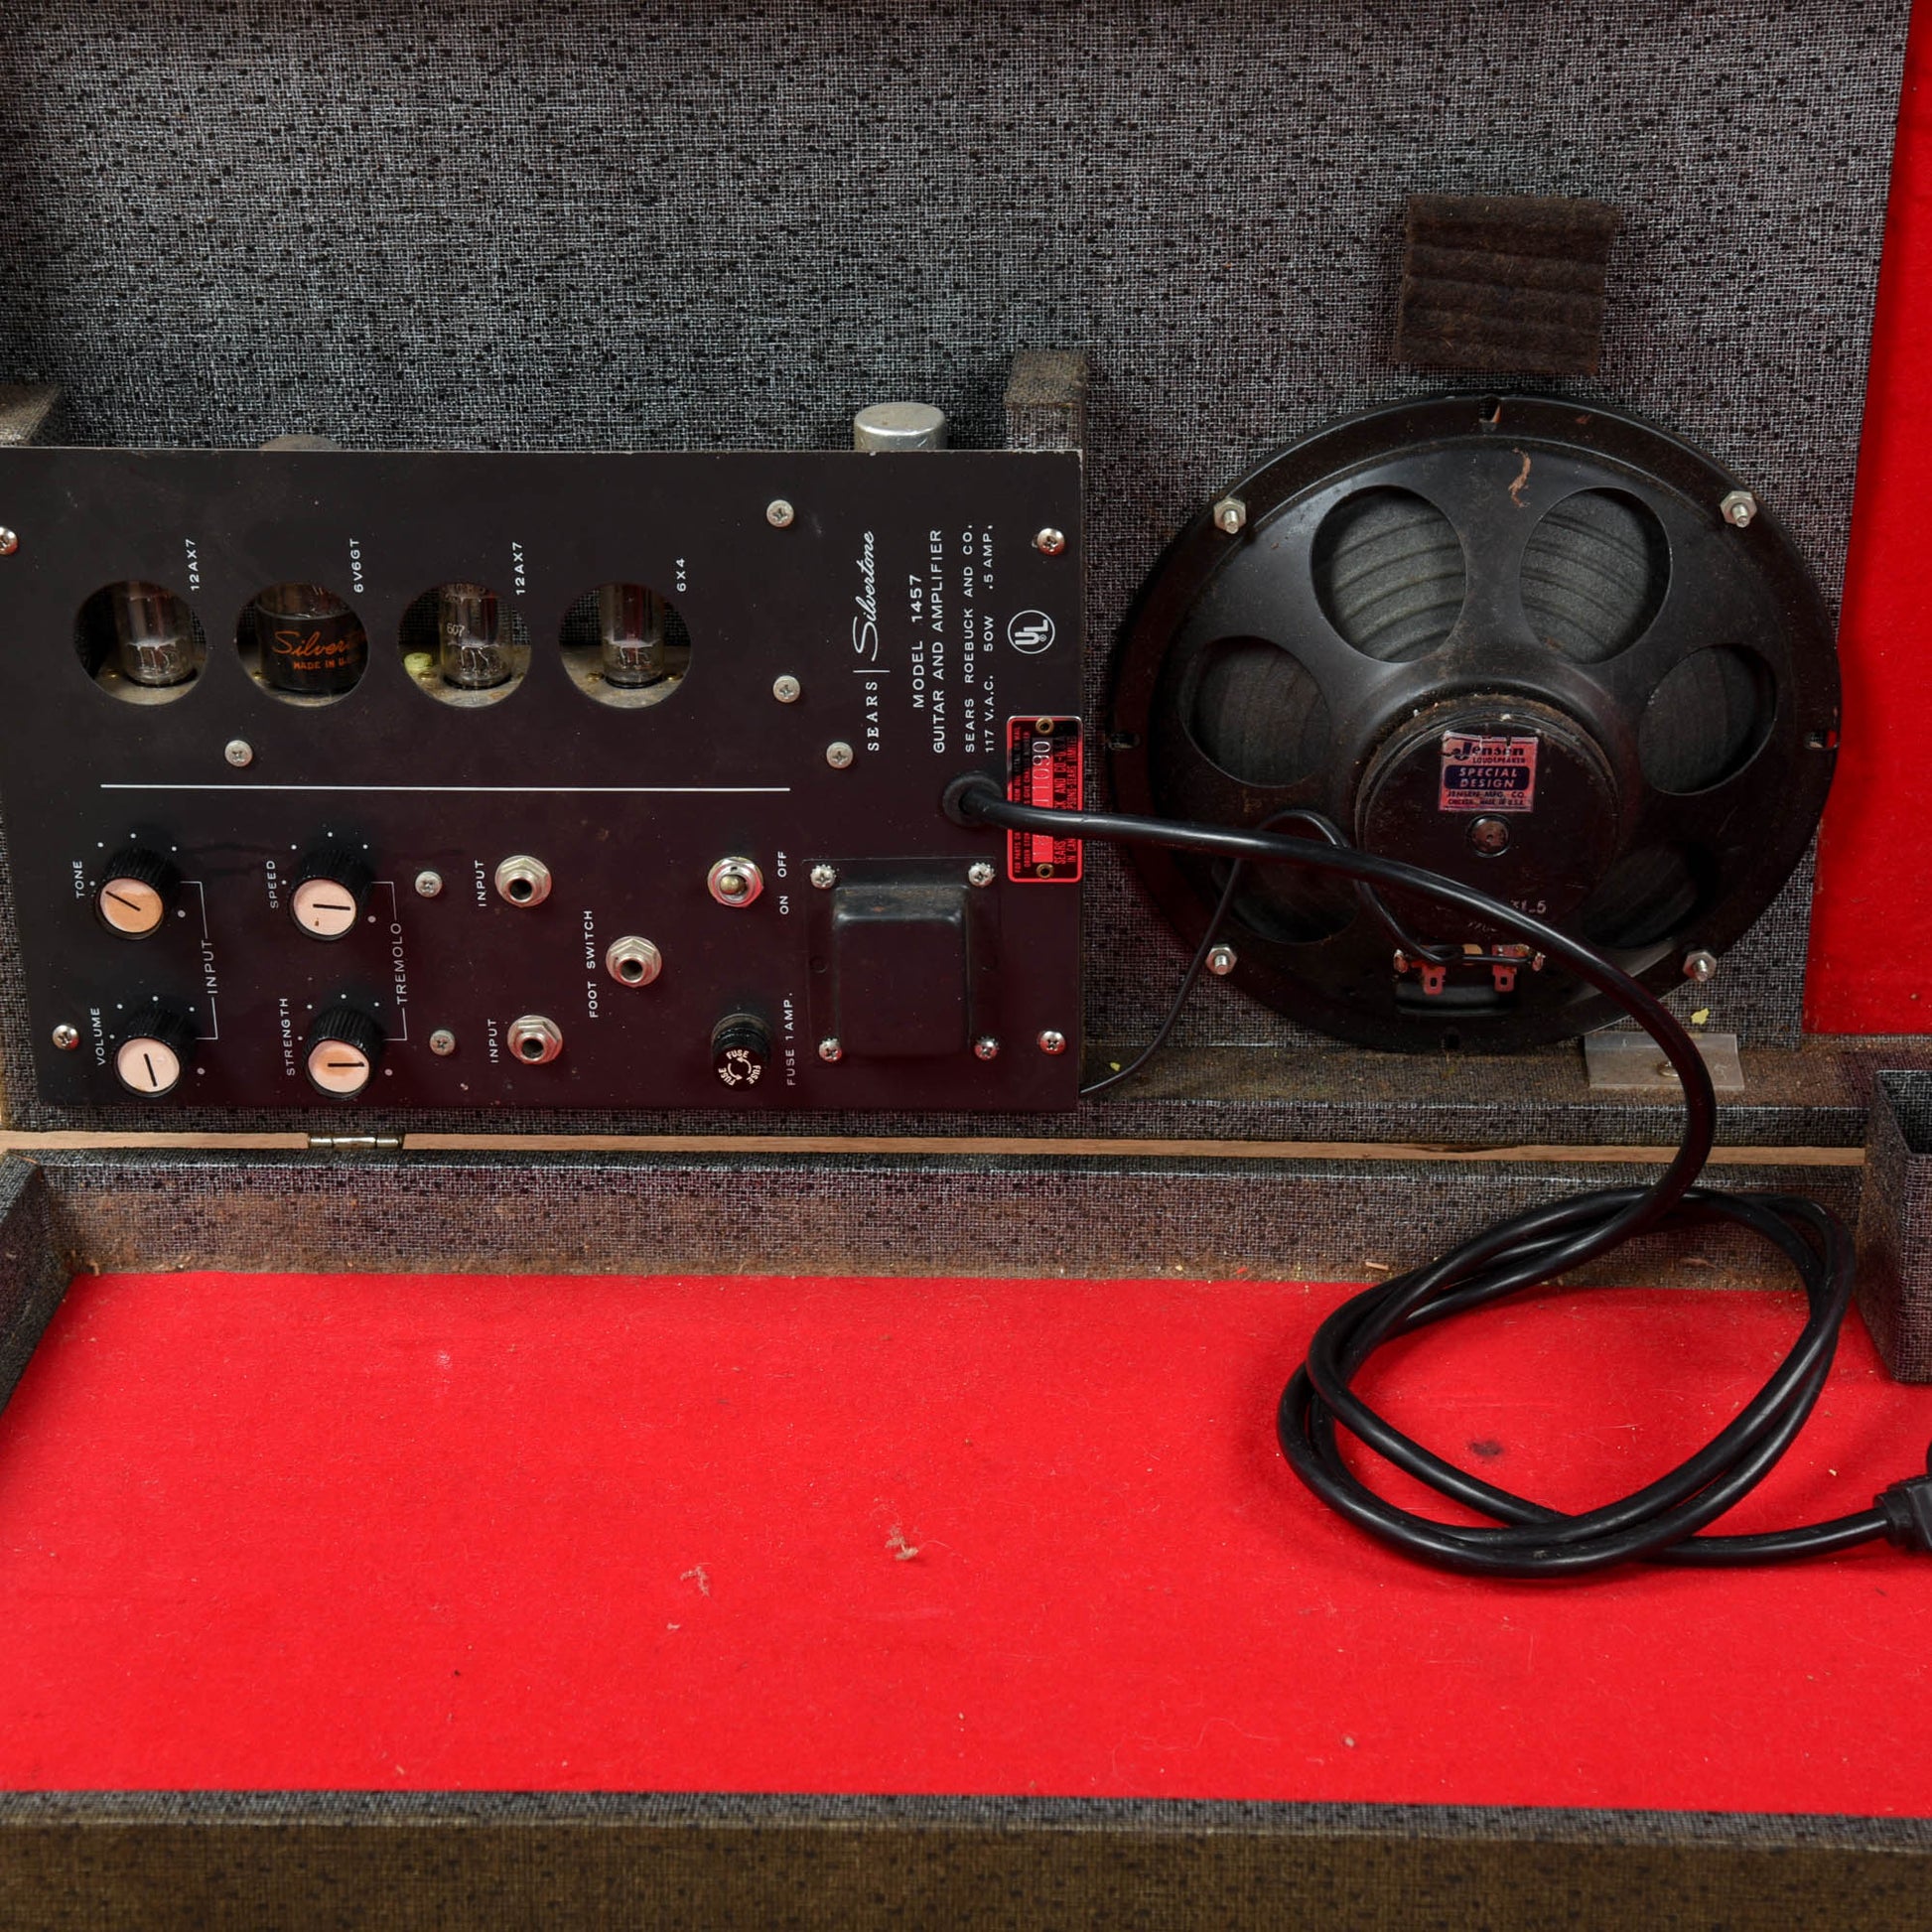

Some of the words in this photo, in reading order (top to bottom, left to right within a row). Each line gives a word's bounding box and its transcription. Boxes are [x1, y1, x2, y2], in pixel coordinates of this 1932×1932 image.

[962, 524, 973, 556] CO.
[982, 524, 993, 568] AMP.
[185, 538, 199, 592] 12AX7
[349, 538, 363, 594] 6V6GT
[512, 541, 526, 596] 12AX7
[675, 558, 687, 592] 6X4
[929, 529, 943, 633] AMPLIFIER
[963, 566, 973, 598] AND
[852, 530, 878, 661] Silvertone
[909, 574, 922, 622] 1457
[963, 608, 974, 684] ROEBUCK
[983, 616, 993, 651] 50W
[293, 661, 322, 671] MADE
[325, 659, 336, 669] IN
[911, 640, 925, 709] MODEL
[931, 641, 944, 680] AND
[866, 681, 880, 752] SEARS
[984, 675, 995, 722] V.A.C.
[933, 690, 945, 754] GUITAR
[965, 698, 975, 753] SEARS
[985, 730, 995, 753] 117
[1452, 742, 1525, 760] Jensen
[1054, 778, 1066, 794] AND
[1459, 767, 1518, 777] SPECIAL
[1459, 778, 1515, 788] DESIGN
[777, 850, 787, 878] OFF
[1054, 840, 1066, 864] SEARS
[72, 860, 85, 898] TONE
[266, 860, 279, 909] SPEED
[475, 860, 486, 907] INPUT
[779, 896, 789, 915] ON
[584, 909, 596, 969] SWITCH
[201, 940, 218, 995] INPUT
[390, 923, 409, 1006] TREMOLO
[588, 981, 598, 1019] FOOT
[783, 993, 794, 1033] AMP.
[89, 1007, 105, 1066] VOLUME
[279, 997, 296, 1076] STRENGTH
[486, 1019, 498, 1062] INPUT
[726, 1048, 750, 1060] FUSE
[718, 1067, 737, 1086] FUSE
[747, 1064, 761, 1084] FUSE
[786, 1048, 795, 1086] FUSE
